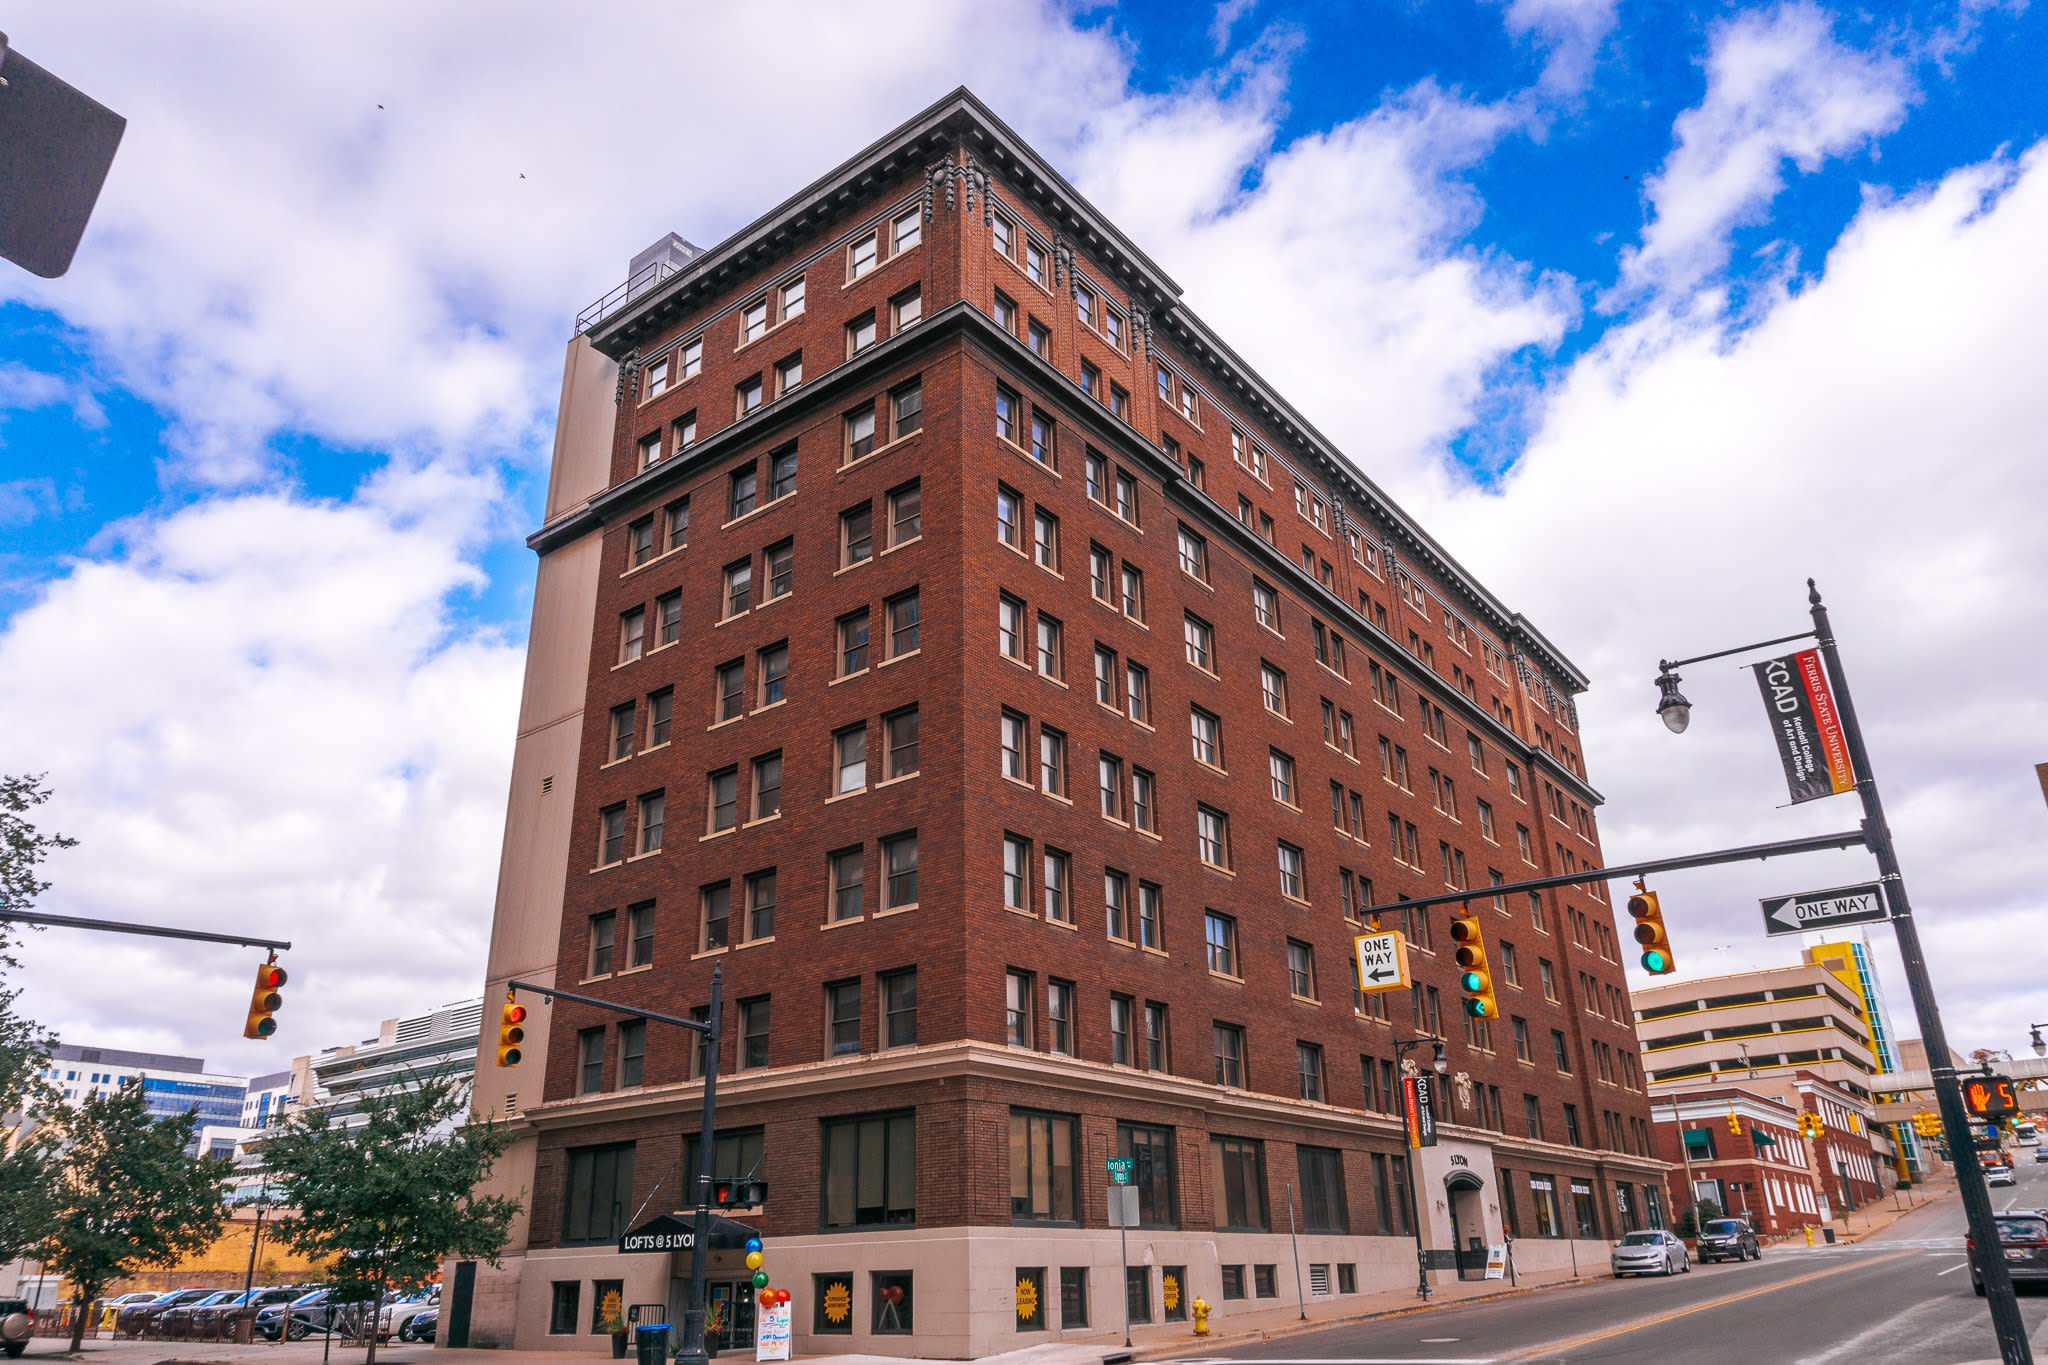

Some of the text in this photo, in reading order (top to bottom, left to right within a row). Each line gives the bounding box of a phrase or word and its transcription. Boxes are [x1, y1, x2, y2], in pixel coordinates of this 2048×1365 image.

[1765, 659, 1799, 713] KCAD
[1783, 719, 1806, 782] of Art and Design
[1793, 716, 1815, 773] Kendall College
[1795, 896, 1869, 919] ONE WAY
[1364, 938, 1390, 952] ONE
[1365, 952, 1392, 966] WAY
[1417, 1078, 1429, 1104] KCAD
[1998, 1083, 2014, 1108] 5
[1107, 1159, 1125, 1170] Ionia
[1450, 1154, 1468, 1168] 5 LYON
[624, 1235, 654, 1249] LOFTS
[656, 1235, 664, 1248] @
[665, 1235, 671, 1248] 5
[1020, 1288, 1031, 1296] NOW
